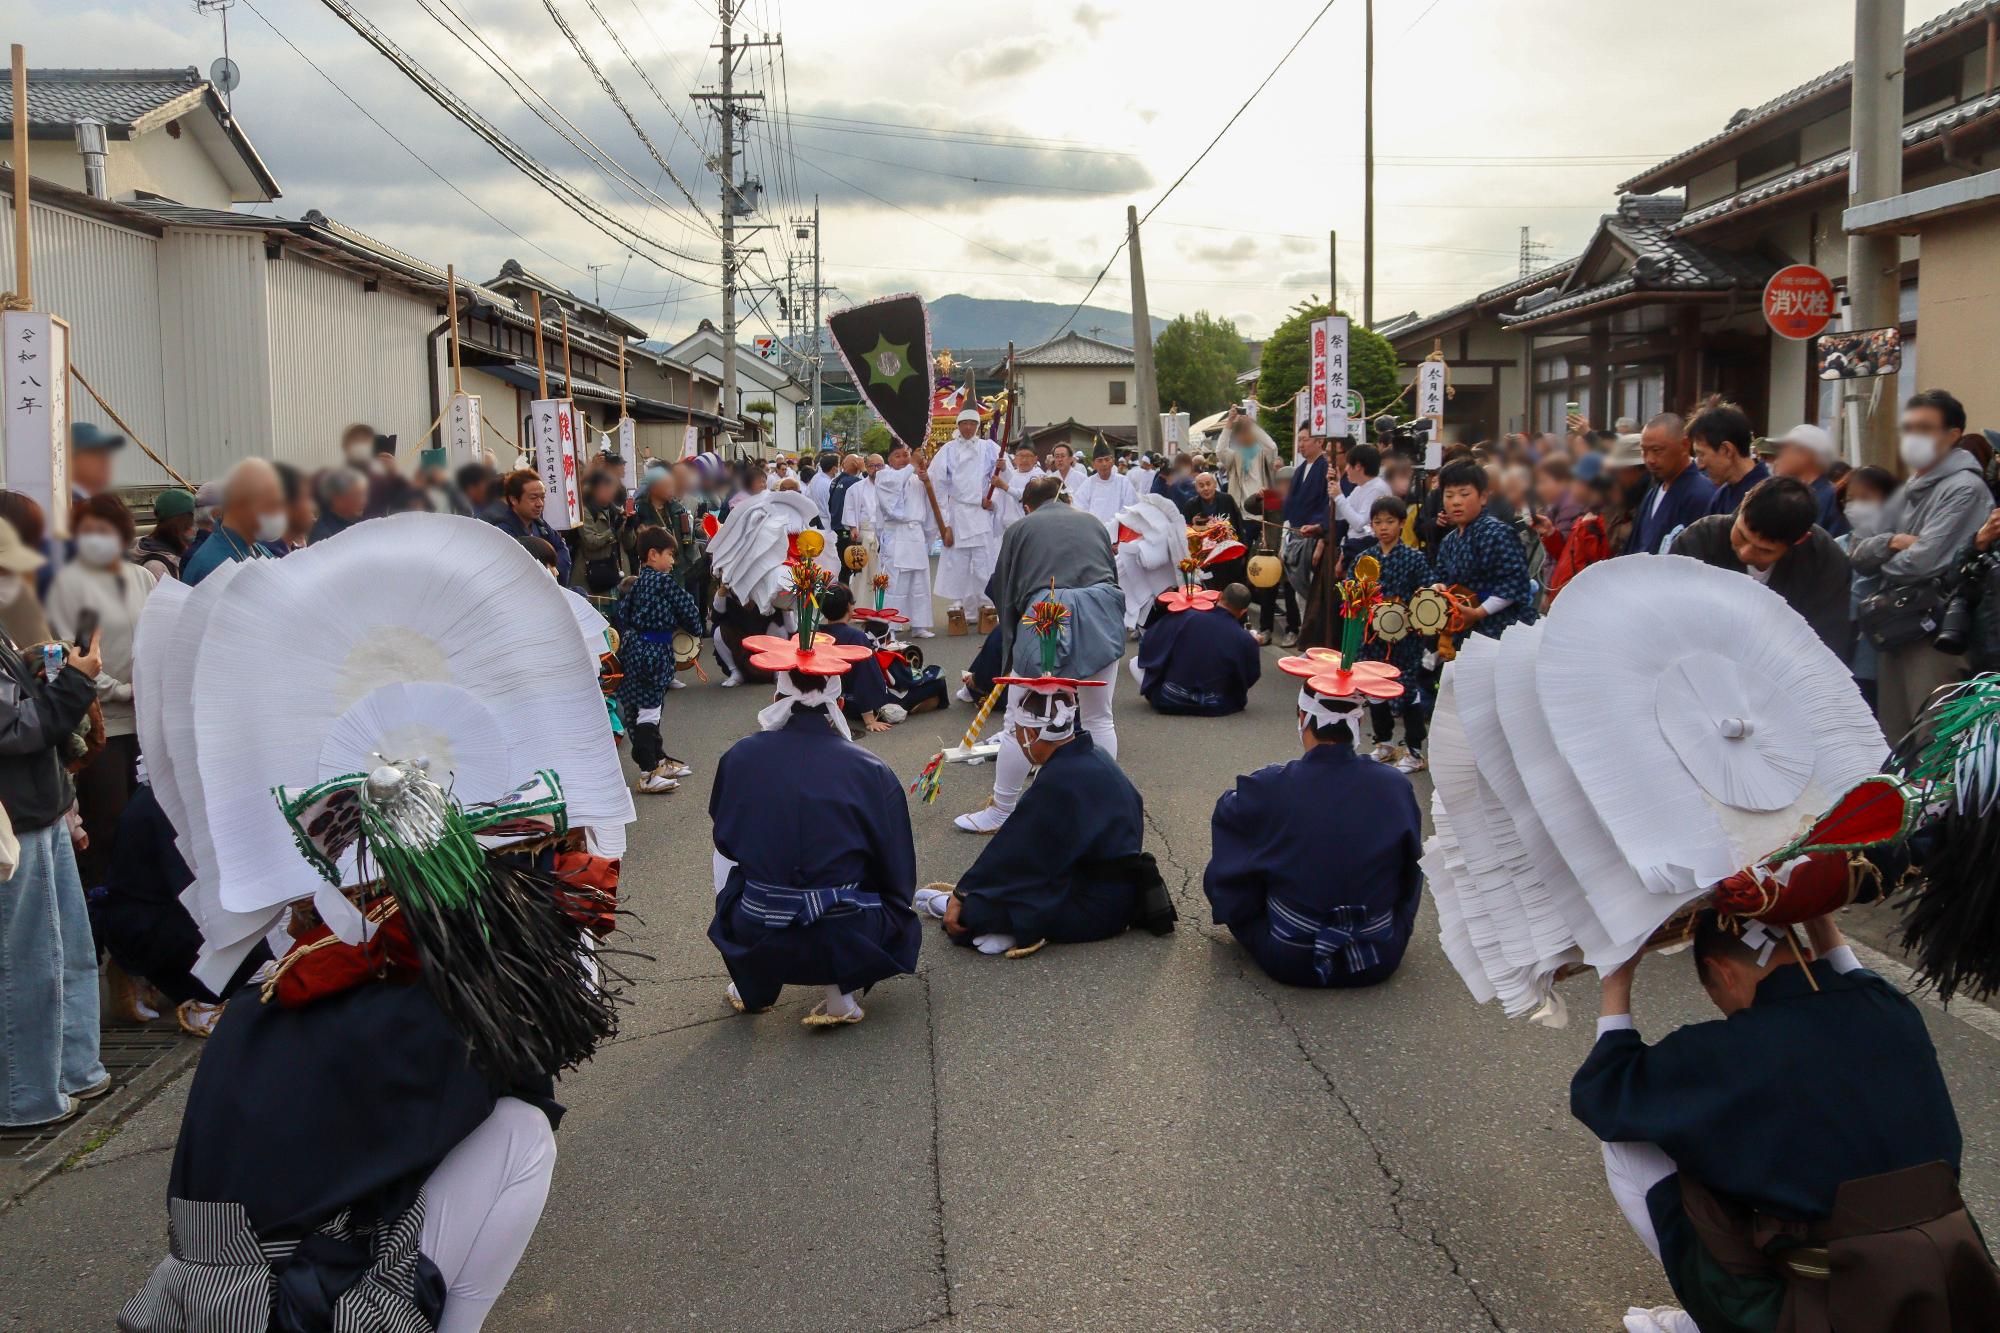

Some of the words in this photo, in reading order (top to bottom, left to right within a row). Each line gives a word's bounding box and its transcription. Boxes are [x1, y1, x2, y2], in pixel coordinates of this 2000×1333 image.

[1769, 289, 1829, 316] 消火栓
[17, 328, 42, 414] 令和八年
[1330, 334, 1346, 409] 祭月祭夜
[455, 405, 467, 448] 令和八年
[542, 413, 557, 494] 令和八年四月吉日
